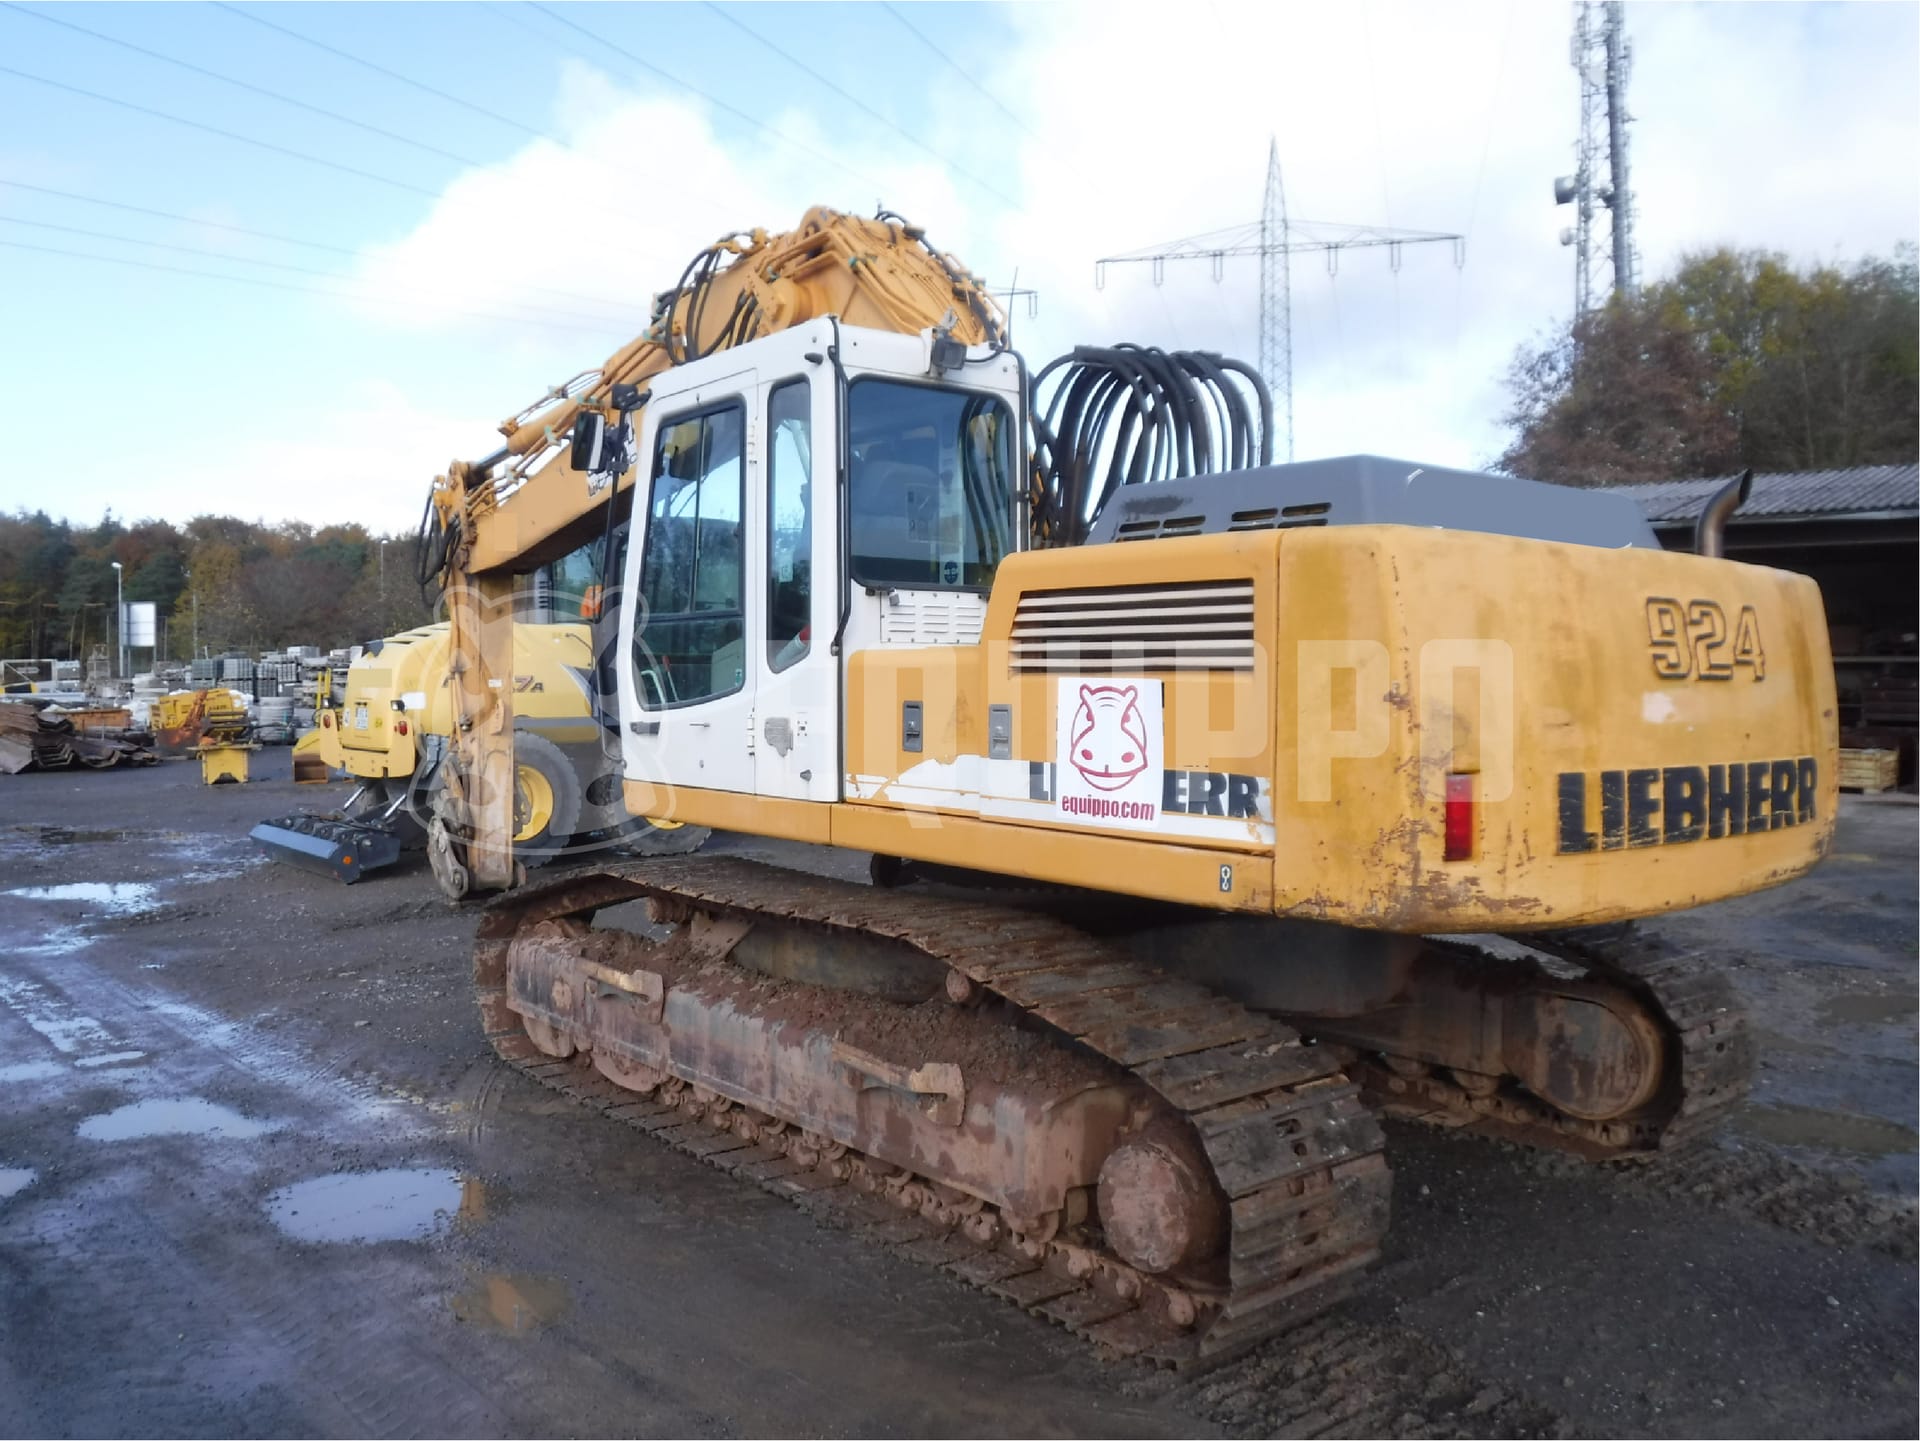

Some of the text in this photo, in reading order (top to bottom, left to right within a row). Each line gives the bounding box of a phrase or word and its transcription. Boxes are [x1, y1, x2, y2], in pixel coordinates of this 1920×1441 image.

[1646, 596, 1765, 683] 924
[1061, 794, 1156, 821] equippo.com
[1555, 756, 1818, 855] LIEBHERR
